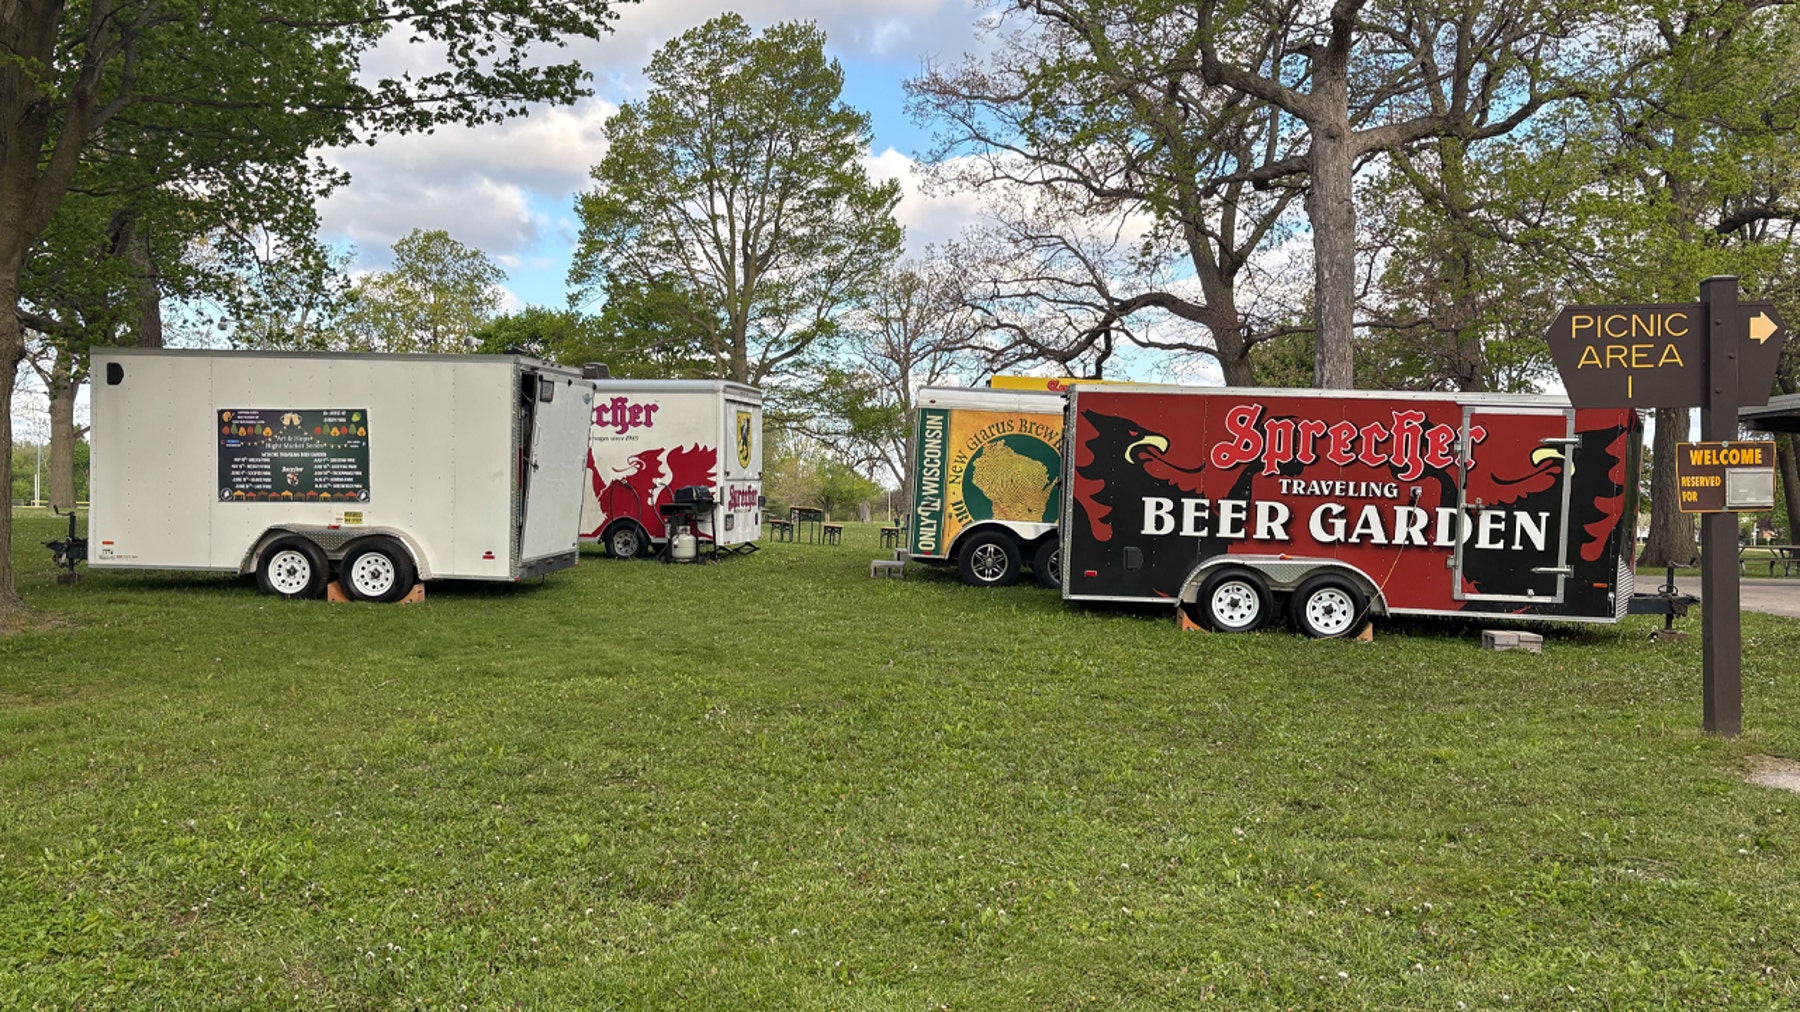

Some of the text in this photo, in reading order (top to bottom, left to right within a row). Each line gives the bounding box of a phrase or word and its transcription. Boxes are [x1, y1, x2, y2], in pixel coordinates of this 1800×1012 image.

[1571, 312, 1689, 339] PICNIC
[1577, 343, 1684, 369] AREA
[591, 396, 659, 435] cher
[921, 413, 944, 496] WISCONSIN
[1210, 403, 1487, 481] Sprecher
[1690, 448, 1763, 466] WELCOME
[1278, 478, 1398, 498] TRAVELING
[1681, 475, 1722, 488] RESERVED
[1681, 491, 1698, 502] FOR
[918, 515, 937, 550] ONLY
[1140, 496, 1550, 551] BEER GARDEN
